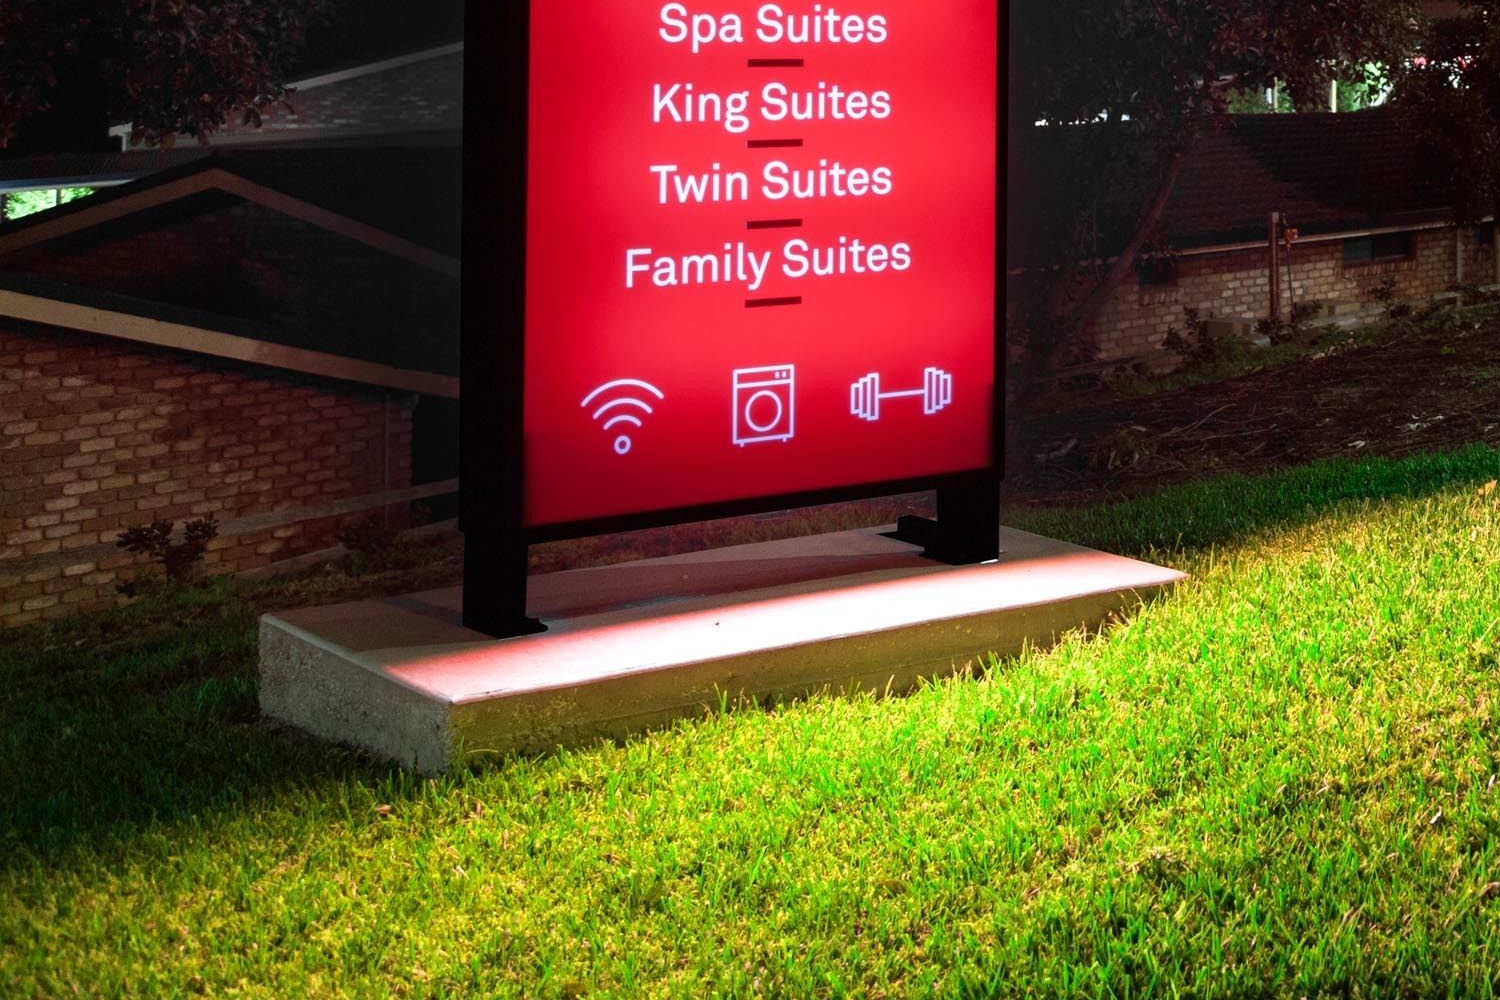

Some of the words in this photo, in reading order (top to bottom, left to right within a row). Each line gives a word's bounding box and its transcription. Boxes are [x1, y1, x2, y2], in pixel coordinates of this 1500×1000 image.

[658, 2, 744, 54] Spa
[755, 3, 888, 44] Suites
[653, 82, 750, 134] King
[760, 81, 892, 122] Suites
[649, 162, 749, 204] Twin
[761, 158, 893, 200] Suites
[626, 241, 772, 291] Family
[781, 235, 911, 278] Suites
